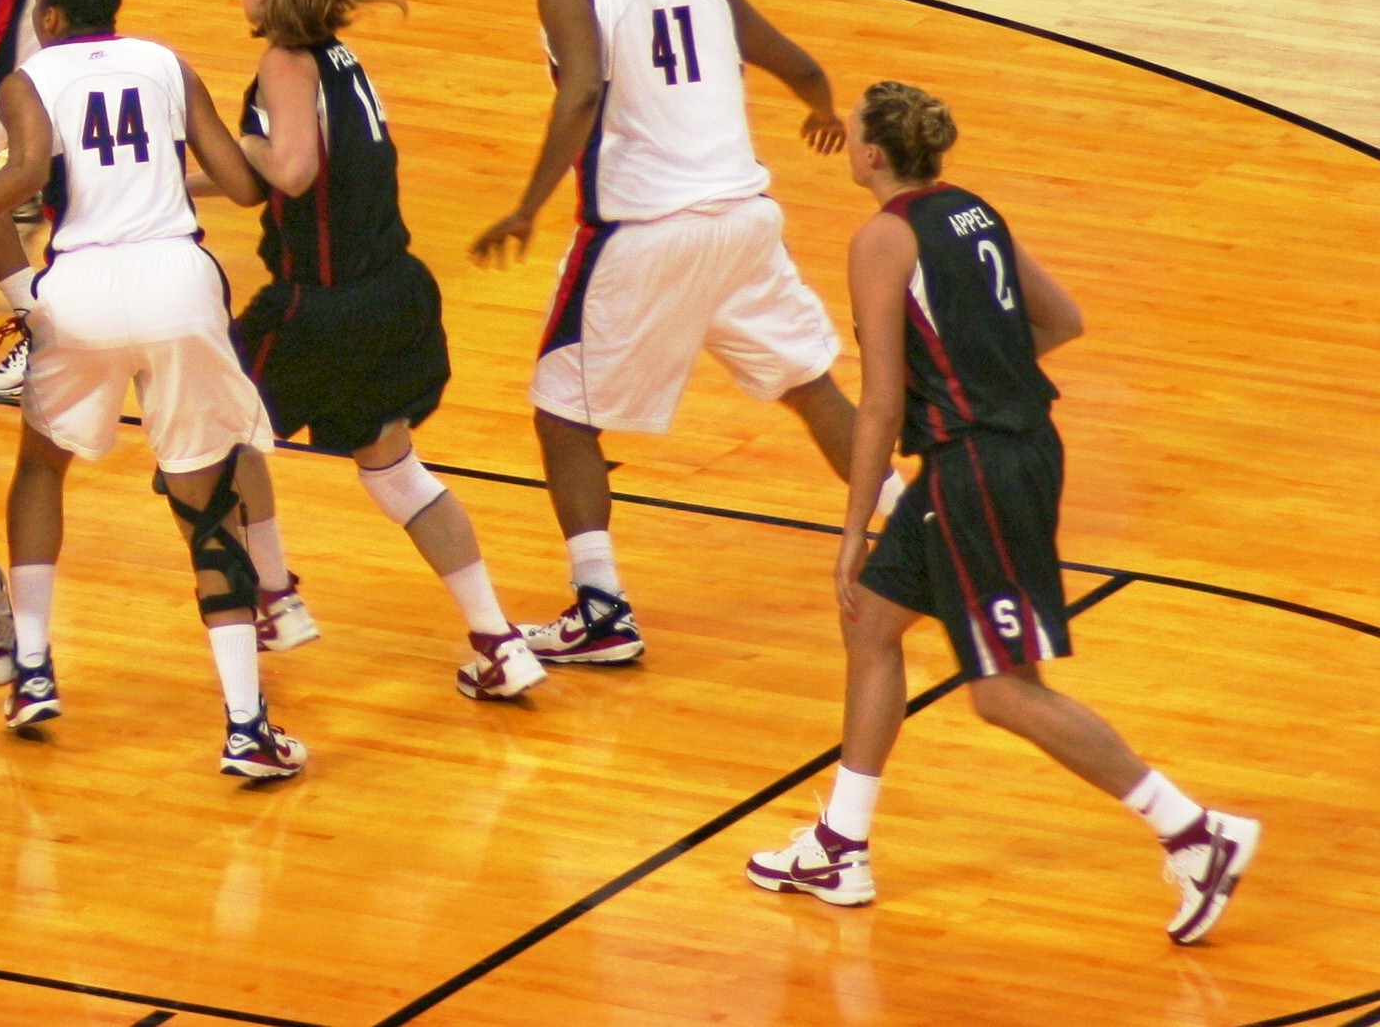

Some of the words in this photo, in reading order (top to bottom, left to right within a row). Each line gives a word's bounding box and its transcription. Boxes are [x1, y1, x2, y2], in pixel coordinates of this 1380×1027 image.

[651, 4, 701, 85] 41
[81, 87, 150, 166] 44
[948, 206, 994, 237] APPEL
[977, 239, 1015, 311] 2
[993, 599, 1021, 638] S
